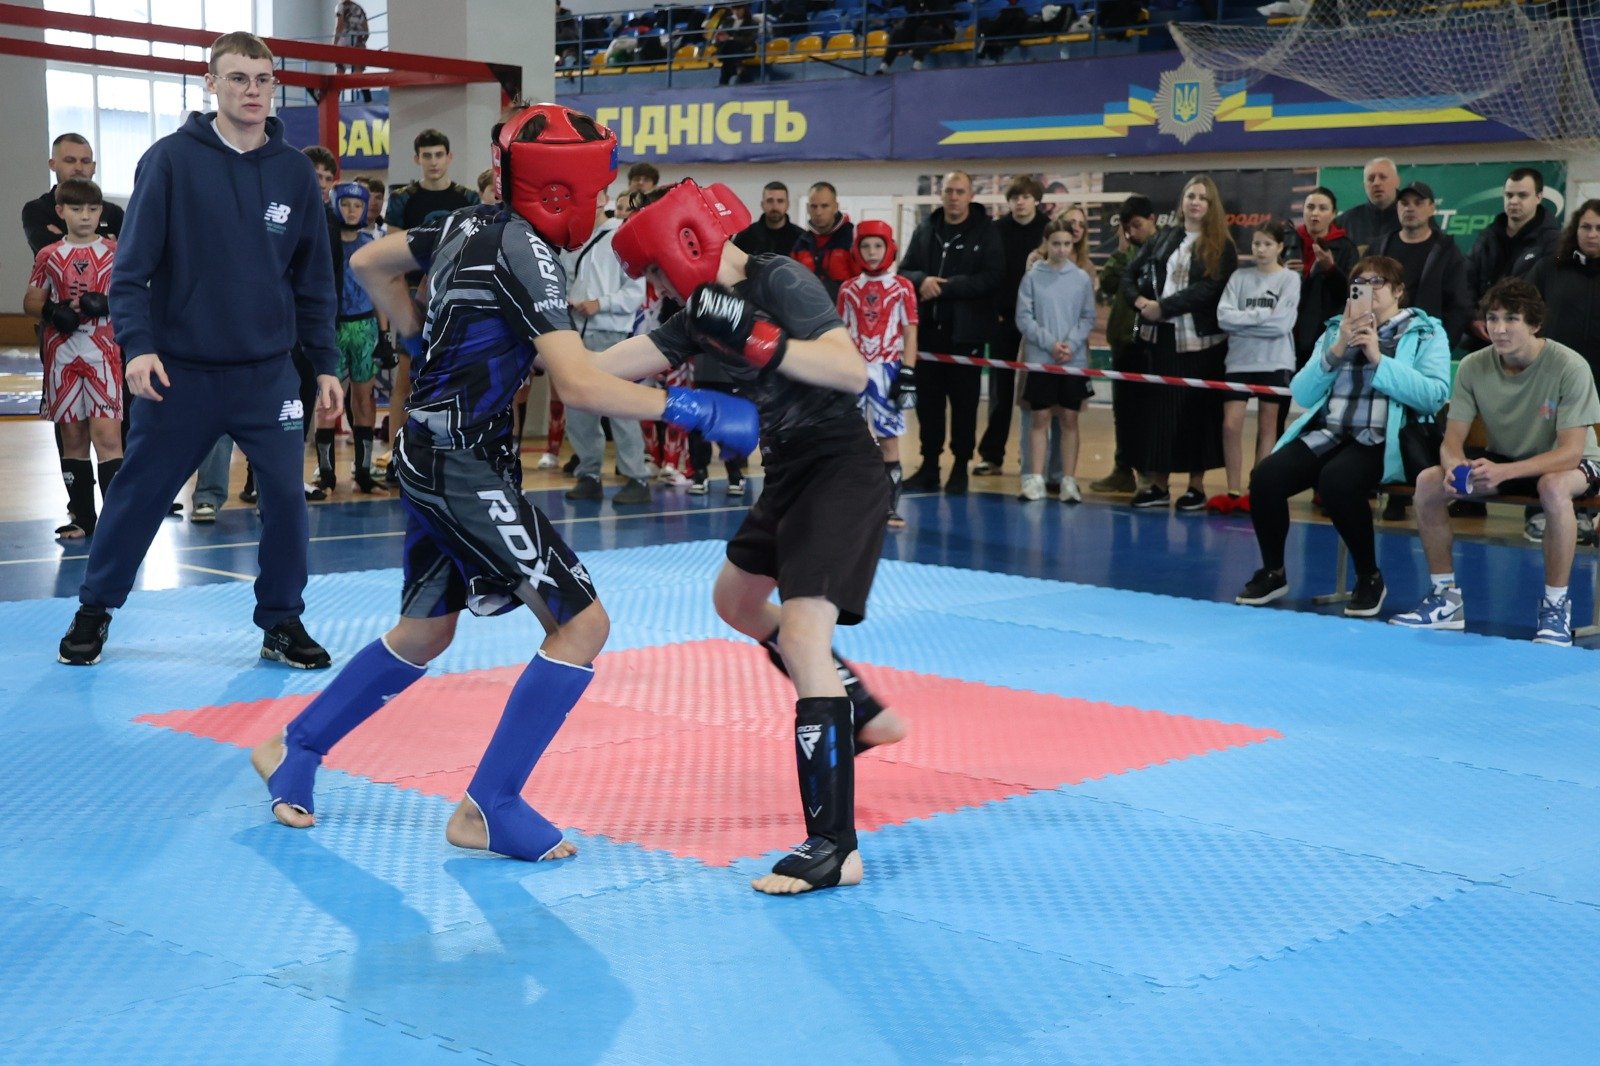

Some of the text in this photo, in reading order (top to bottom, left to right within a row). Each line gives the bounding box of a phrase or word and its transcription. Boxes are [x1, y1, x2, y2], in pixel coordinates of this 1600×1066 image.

[596, 100, 807, 155] ГІДНІСТЬ
[525, 231, 559, 282] RDX
[1246, 298, 1275, 309] PUMA
[476, 490, 559, 590] RDX
